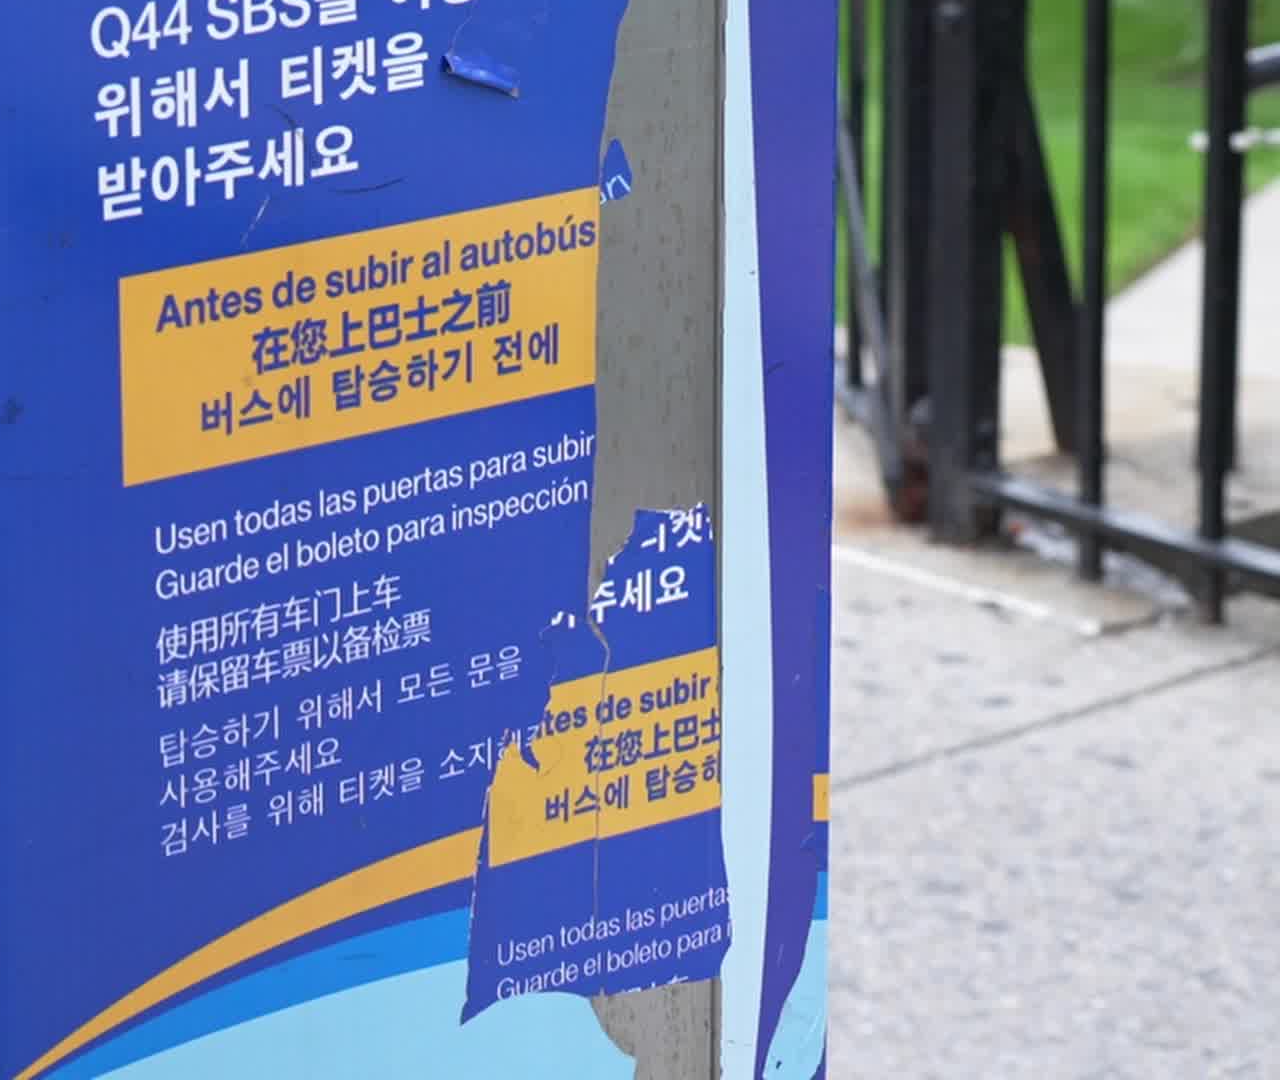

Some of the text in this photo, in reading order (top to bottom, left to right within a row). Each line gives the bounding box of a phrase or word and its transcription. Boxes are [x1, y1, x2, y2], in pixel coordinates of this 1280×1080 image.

[95, 31, 429, 138] 위해서 티켓을
[97, 124, 359, 223] 받아주세요
[156, 215, 596, 333] Antes de subir al autobús
[252, 279, 511, 375] 在您上巴士之前
[201, 323, 560, 436] 버스에 탑승하기 전에
[154, 431, 595, 554] Usen todas las puertas para subir
[155, 476, 589, 601] Guarde el boleto para inspección
[156, 573, 402, 664] 使用所有车门上车
[156, 608, 433, 708] 请保留车票以备检票
[160, 644, 522, 768] 탑승하기 위해서 모든 문을
[583, 707, 721, 774] 在您上巴士
[596, 673, 711, 724] de subir
[160, 736, 342, 808] 사용해주세요
[161, 757, 425, 857] 검사를 위해 티켓을
[545, 774, 630, 823] 버스에
[496, 923, 721, 1001] Guarde el boleto para
[497, 906, 655, 967] Usen todas las
